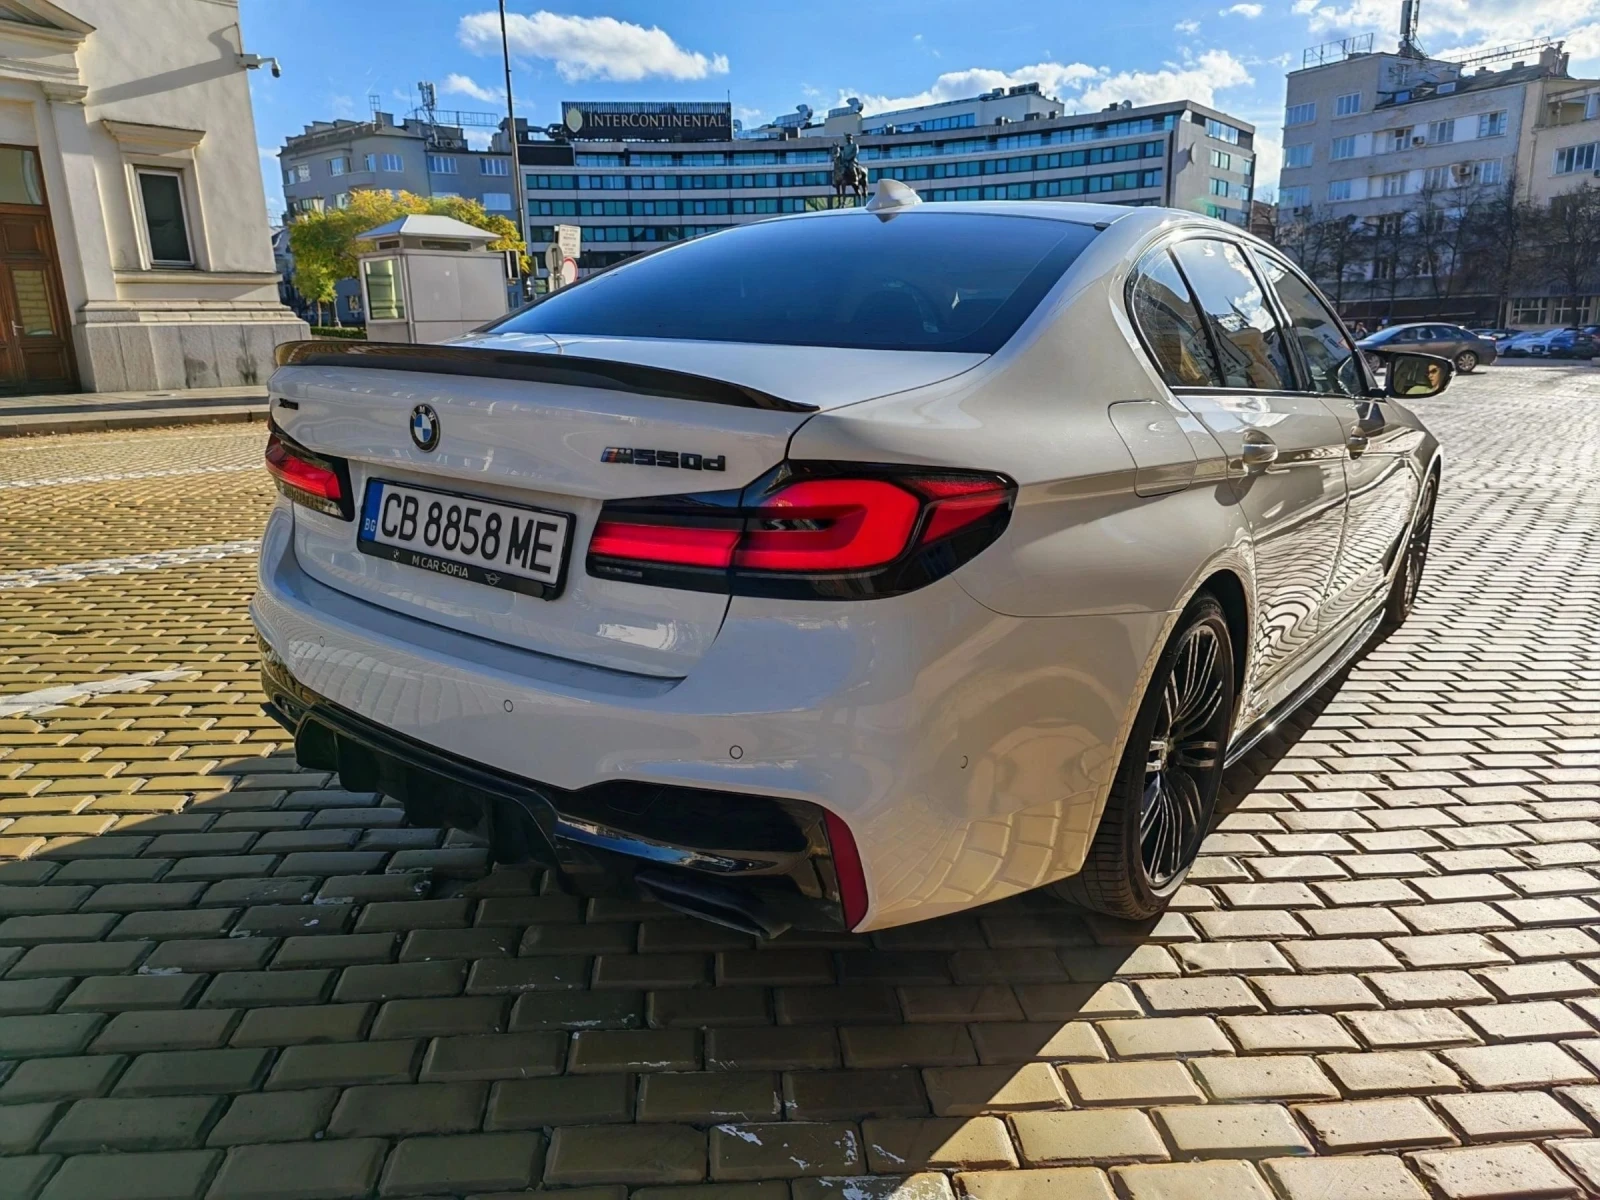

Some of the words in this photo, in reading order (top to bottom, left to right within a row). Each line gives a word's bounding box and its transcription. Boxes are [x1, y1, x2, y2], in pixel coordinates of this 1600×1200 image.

[364, 518, 377, 532] BG
[381, 493, 418, 541] CB
[423, 502, 502, 560] 8858
[505, 516, 558, 574] ME
[412, 555, 420, 566] M
[421, 557, 440, 570] CAR
[441, 561, 468, 578] SOFIA
